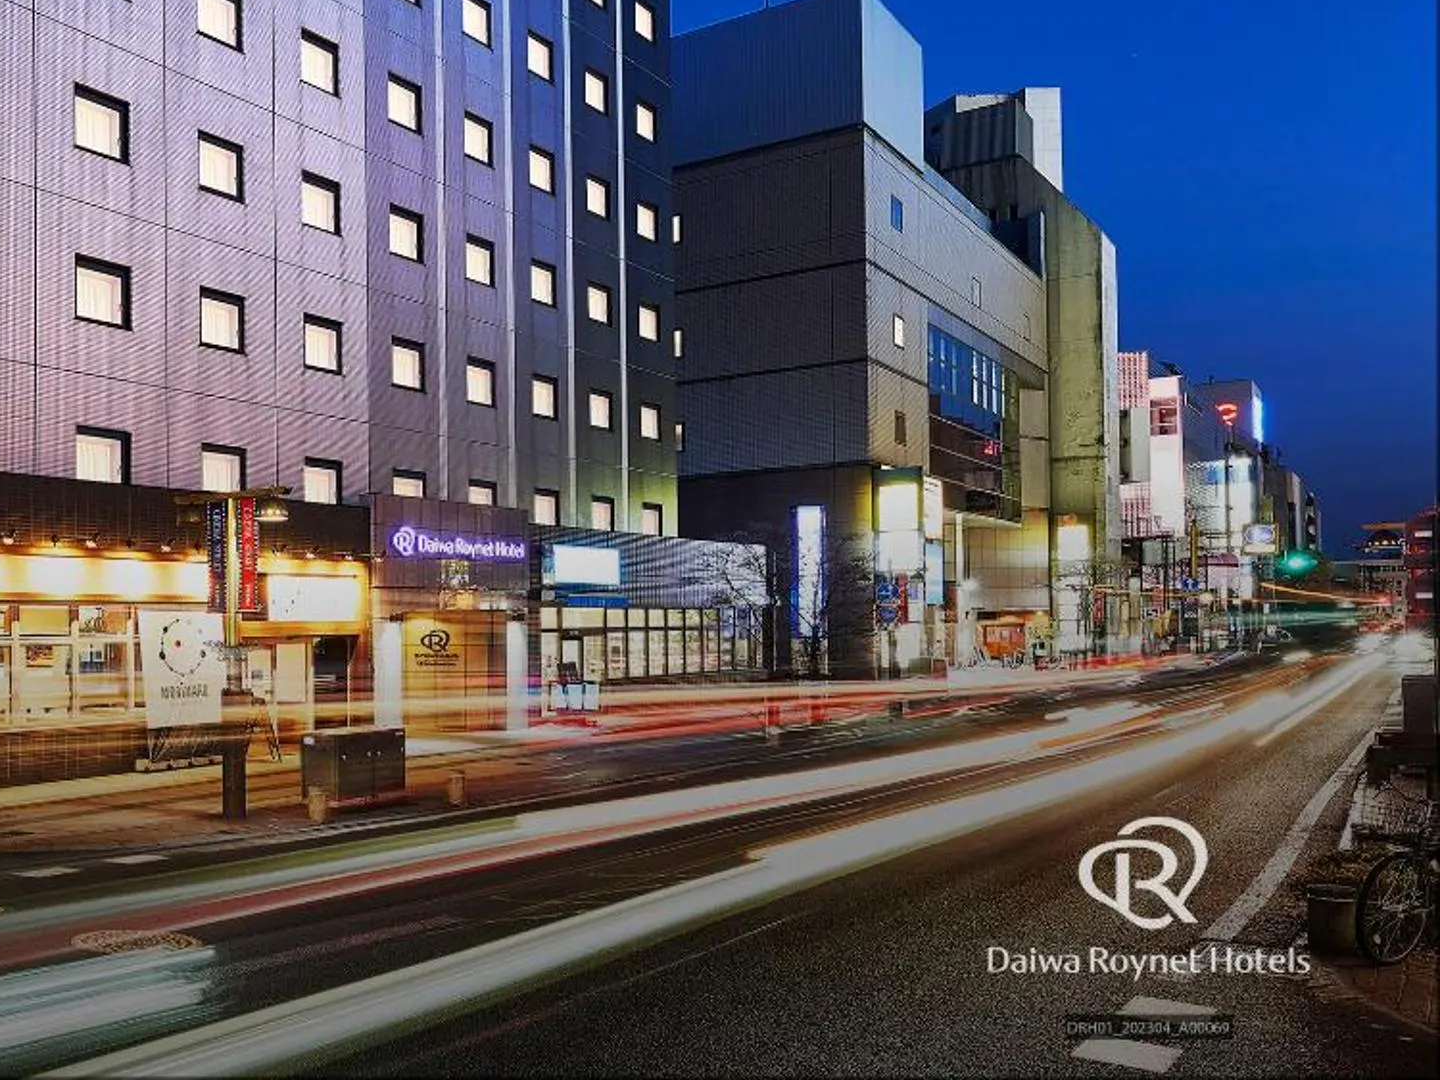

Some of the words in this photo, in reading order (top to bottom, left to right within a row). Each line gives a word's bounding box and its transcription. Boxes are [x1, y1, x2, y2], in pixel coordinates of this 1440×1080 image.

[418, 535, 454, 555] Daiwa
[456, 537, 494, 558] Roynet
[495, 541, 525, 558] Hotel
